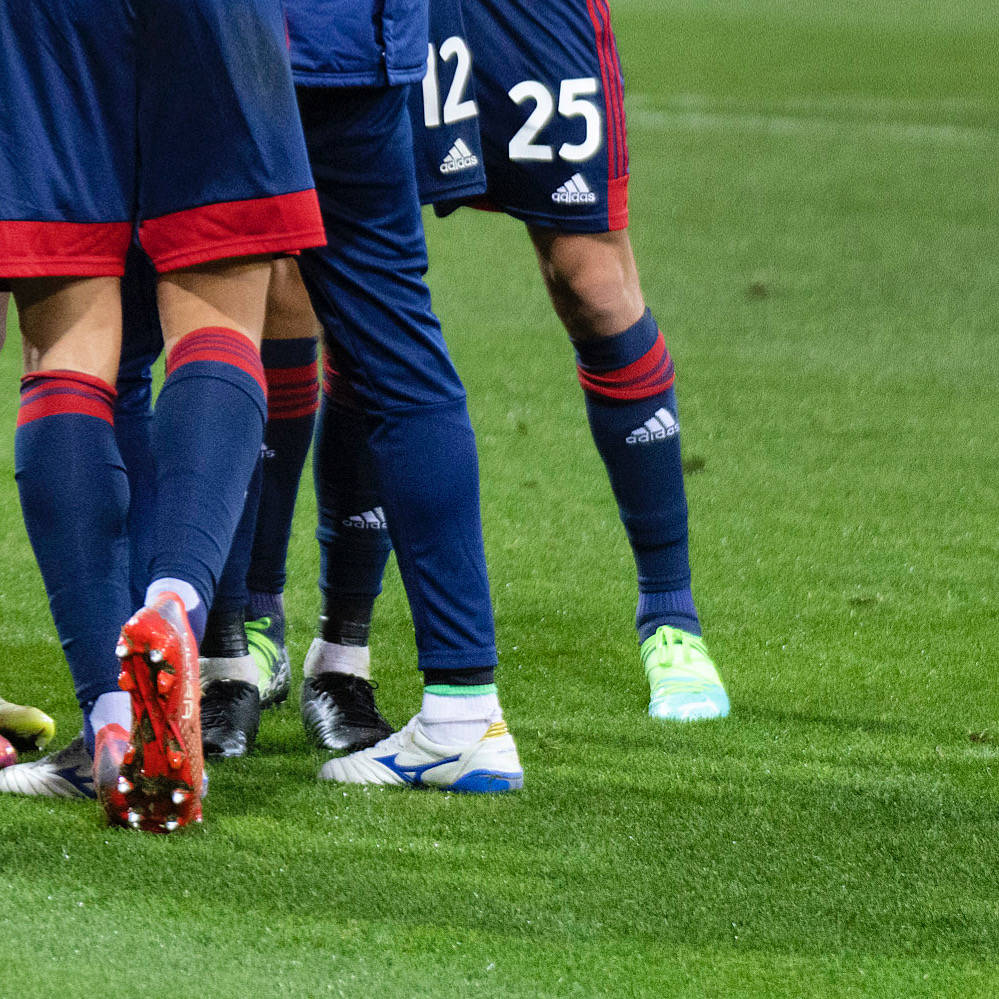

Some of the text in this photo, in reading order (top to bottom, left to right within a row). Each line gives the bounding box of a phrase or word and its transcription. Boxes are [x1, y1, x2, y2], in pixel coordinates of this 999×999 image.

[422, 36, 478, 127] 12
[508, 77, 601, 161] 25
[625, 423, 680, 444] adidas
